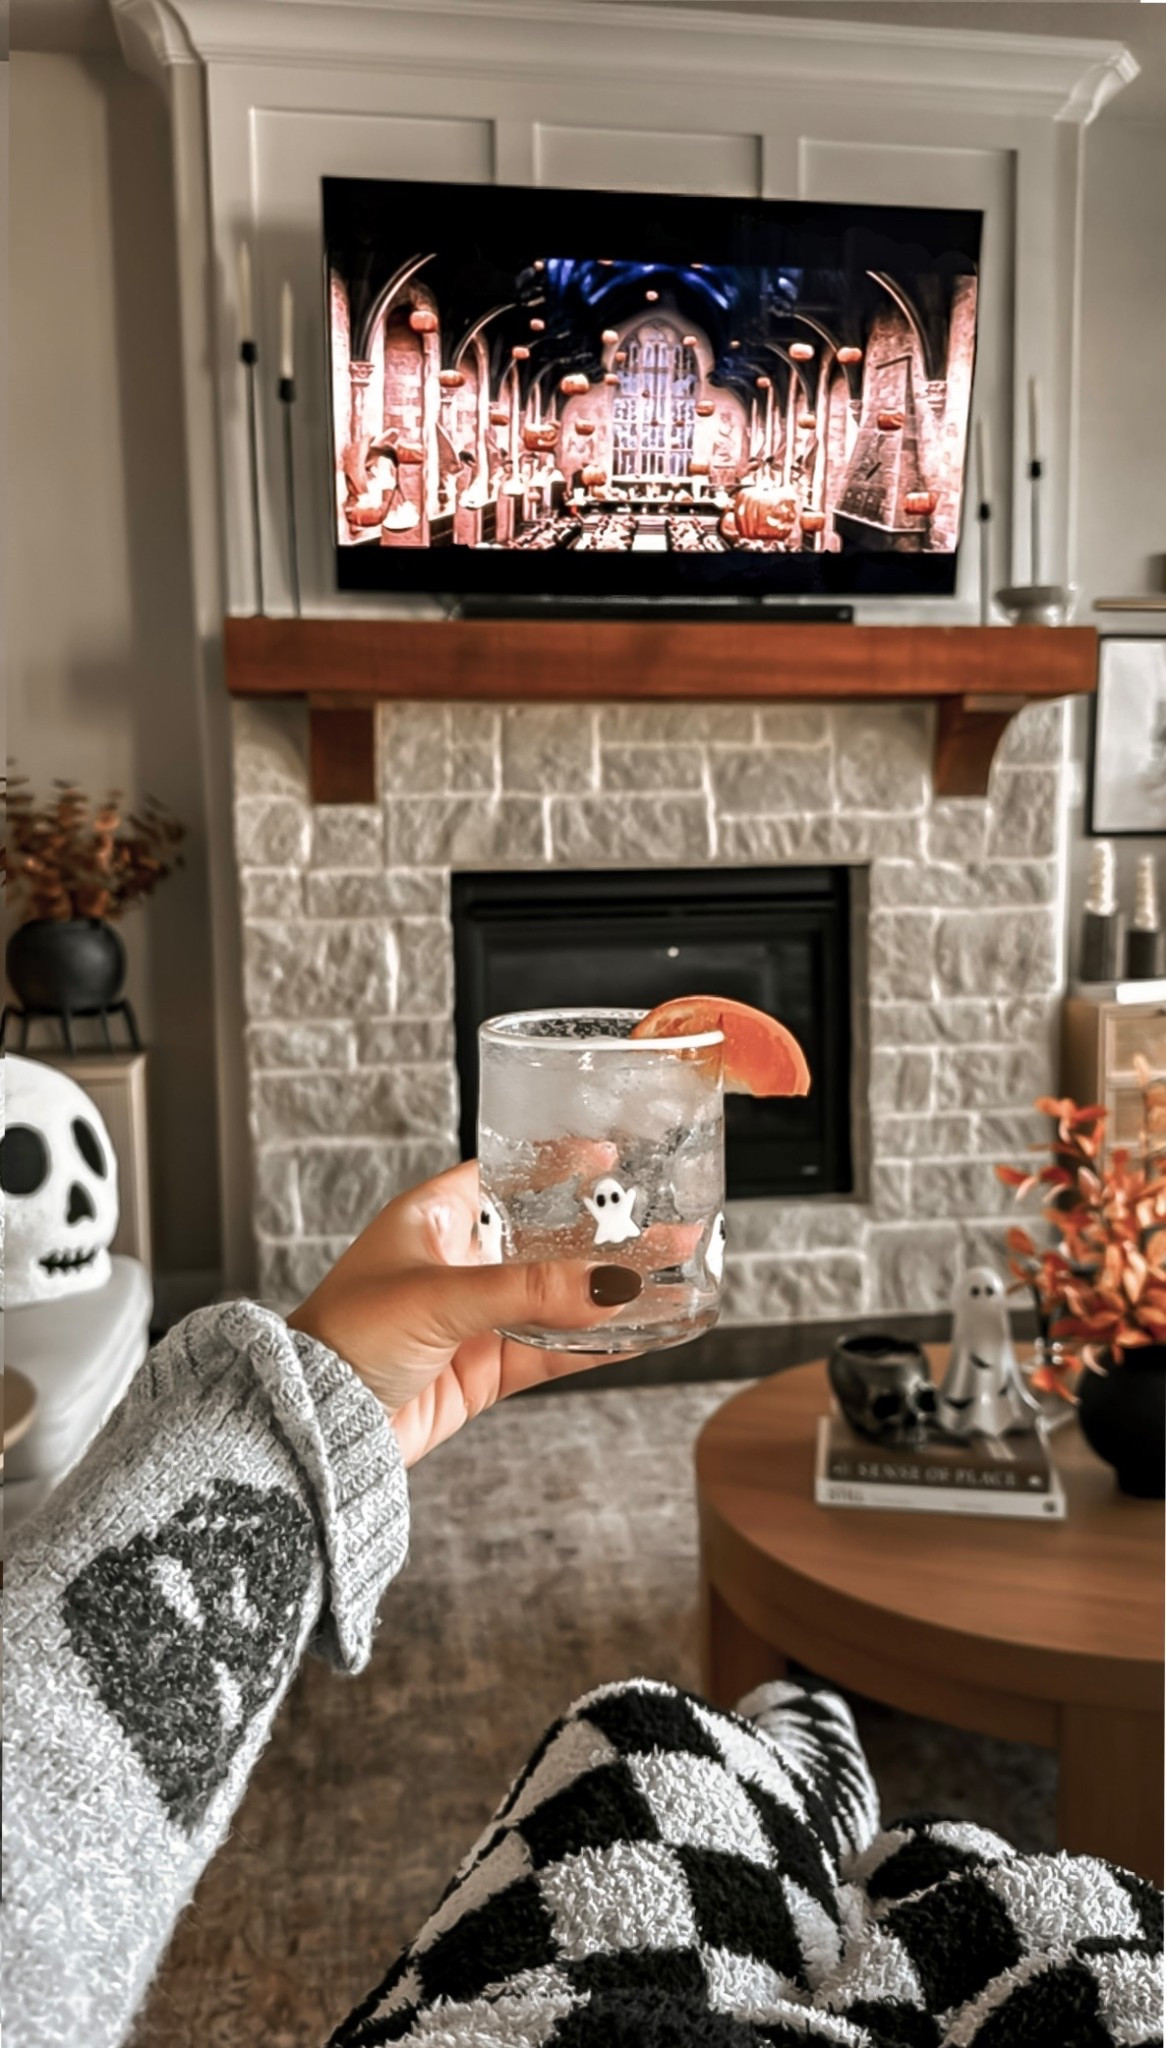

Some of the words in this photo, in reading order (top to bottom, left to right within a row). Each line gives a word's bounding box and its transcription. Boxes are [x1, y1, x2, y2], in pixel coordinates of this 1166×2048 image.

[858, 1462, 920, 1480] SENSE
[924, 1465, 950, 1482] OF
[955, 1468, 1016, 1486] PLACE
